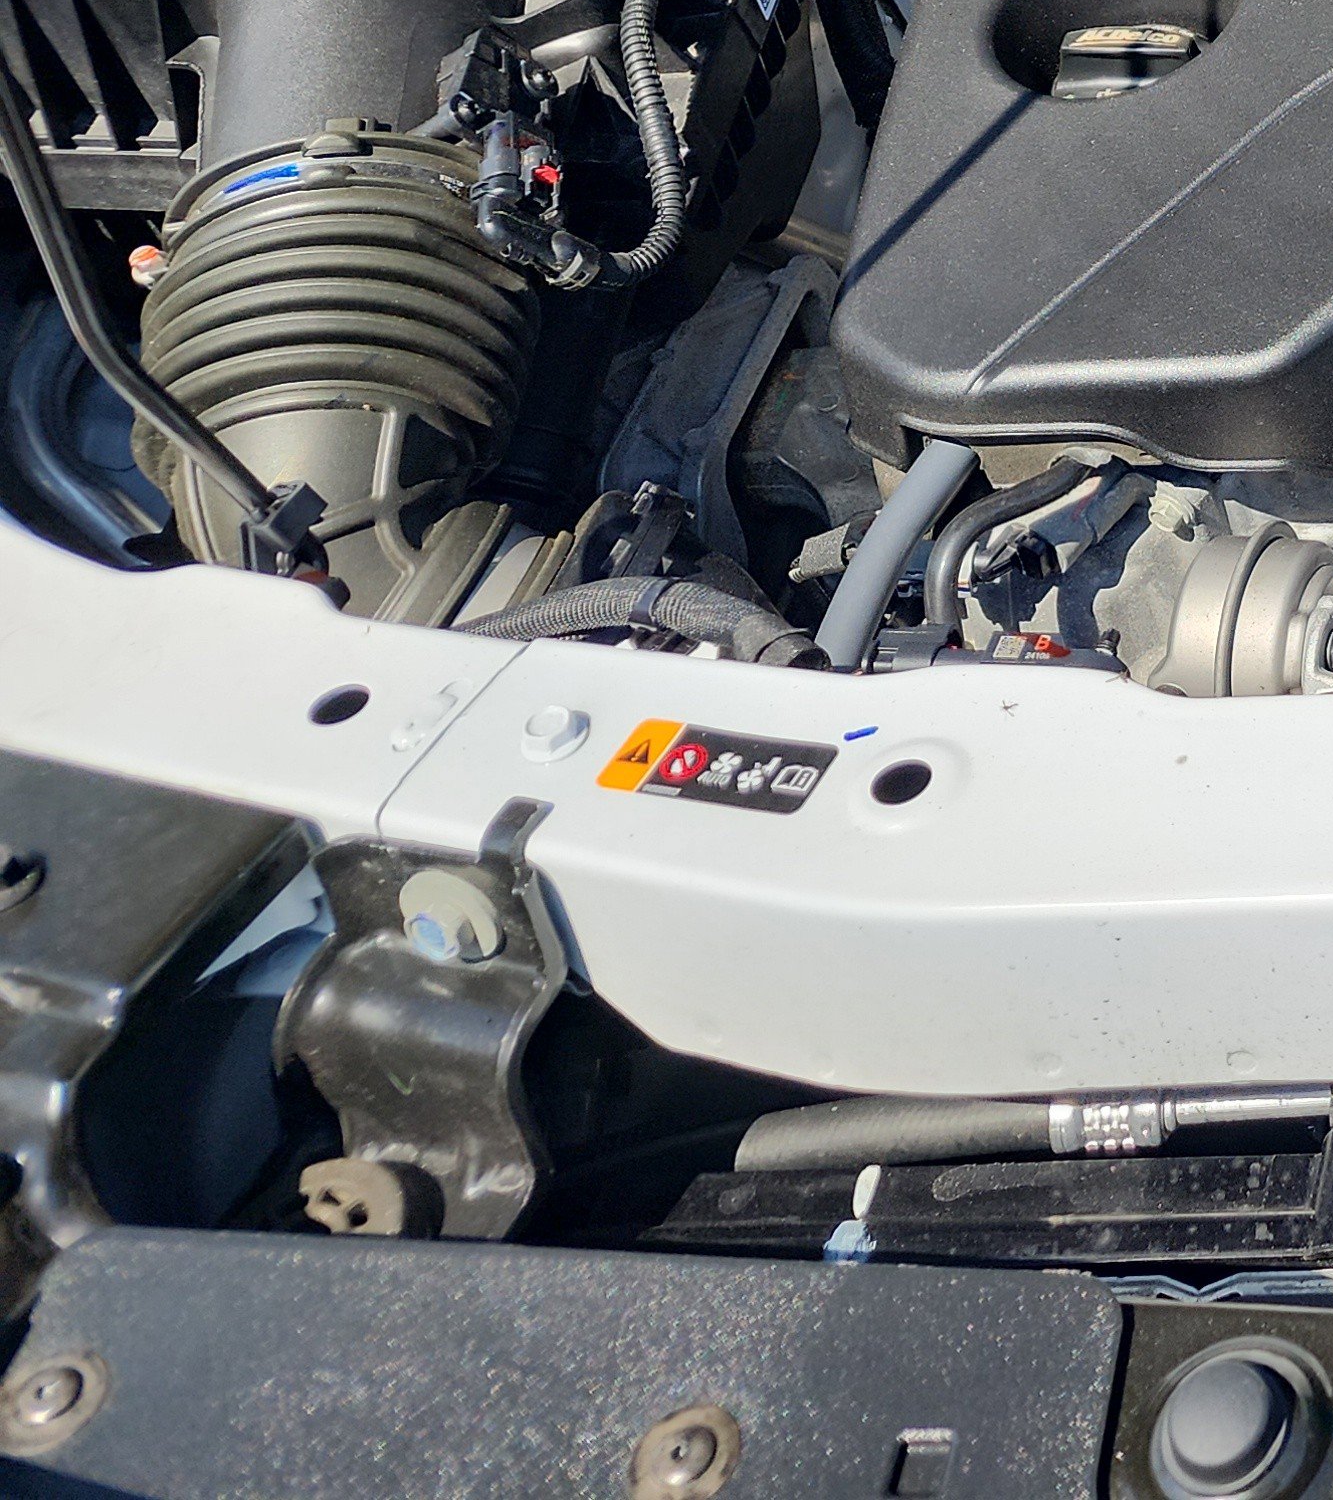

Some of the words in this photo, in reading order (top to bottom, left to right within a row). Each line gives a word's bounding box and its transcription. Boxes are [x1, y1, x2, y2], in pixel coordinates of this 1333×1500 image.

[1075, 28, 1182, 43] ACDelco
[1034, 634, 1052, 651] B
[698, 771, 730, 787] AUTO
